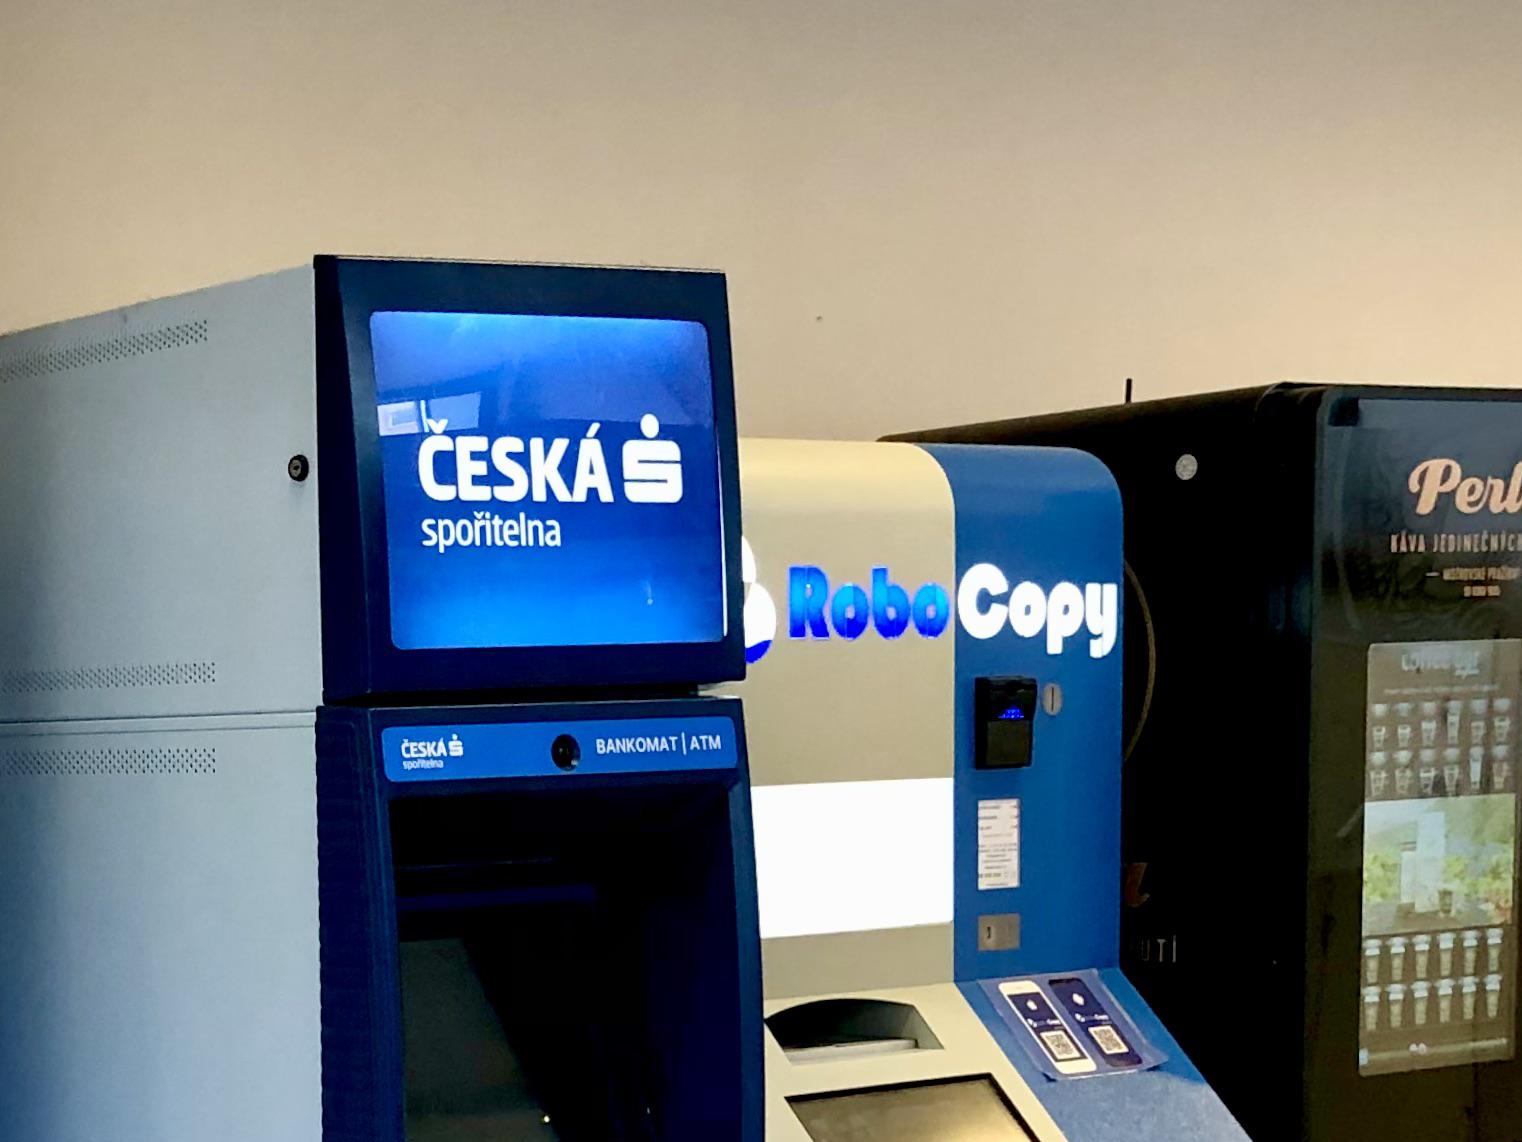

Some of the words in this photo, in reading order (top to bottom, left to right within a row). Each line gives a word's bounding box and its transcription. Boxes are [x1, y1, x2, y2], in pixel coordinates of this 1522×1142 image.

[418, 418, 614, 503] ČESKÁ
[421, 511, 561, 553] spořitelna
[401, 737, 447, 758] ČESKÁ
[596, 735, 678, 755] BANKOMAT
[690, 734, 721, 751] ATM
